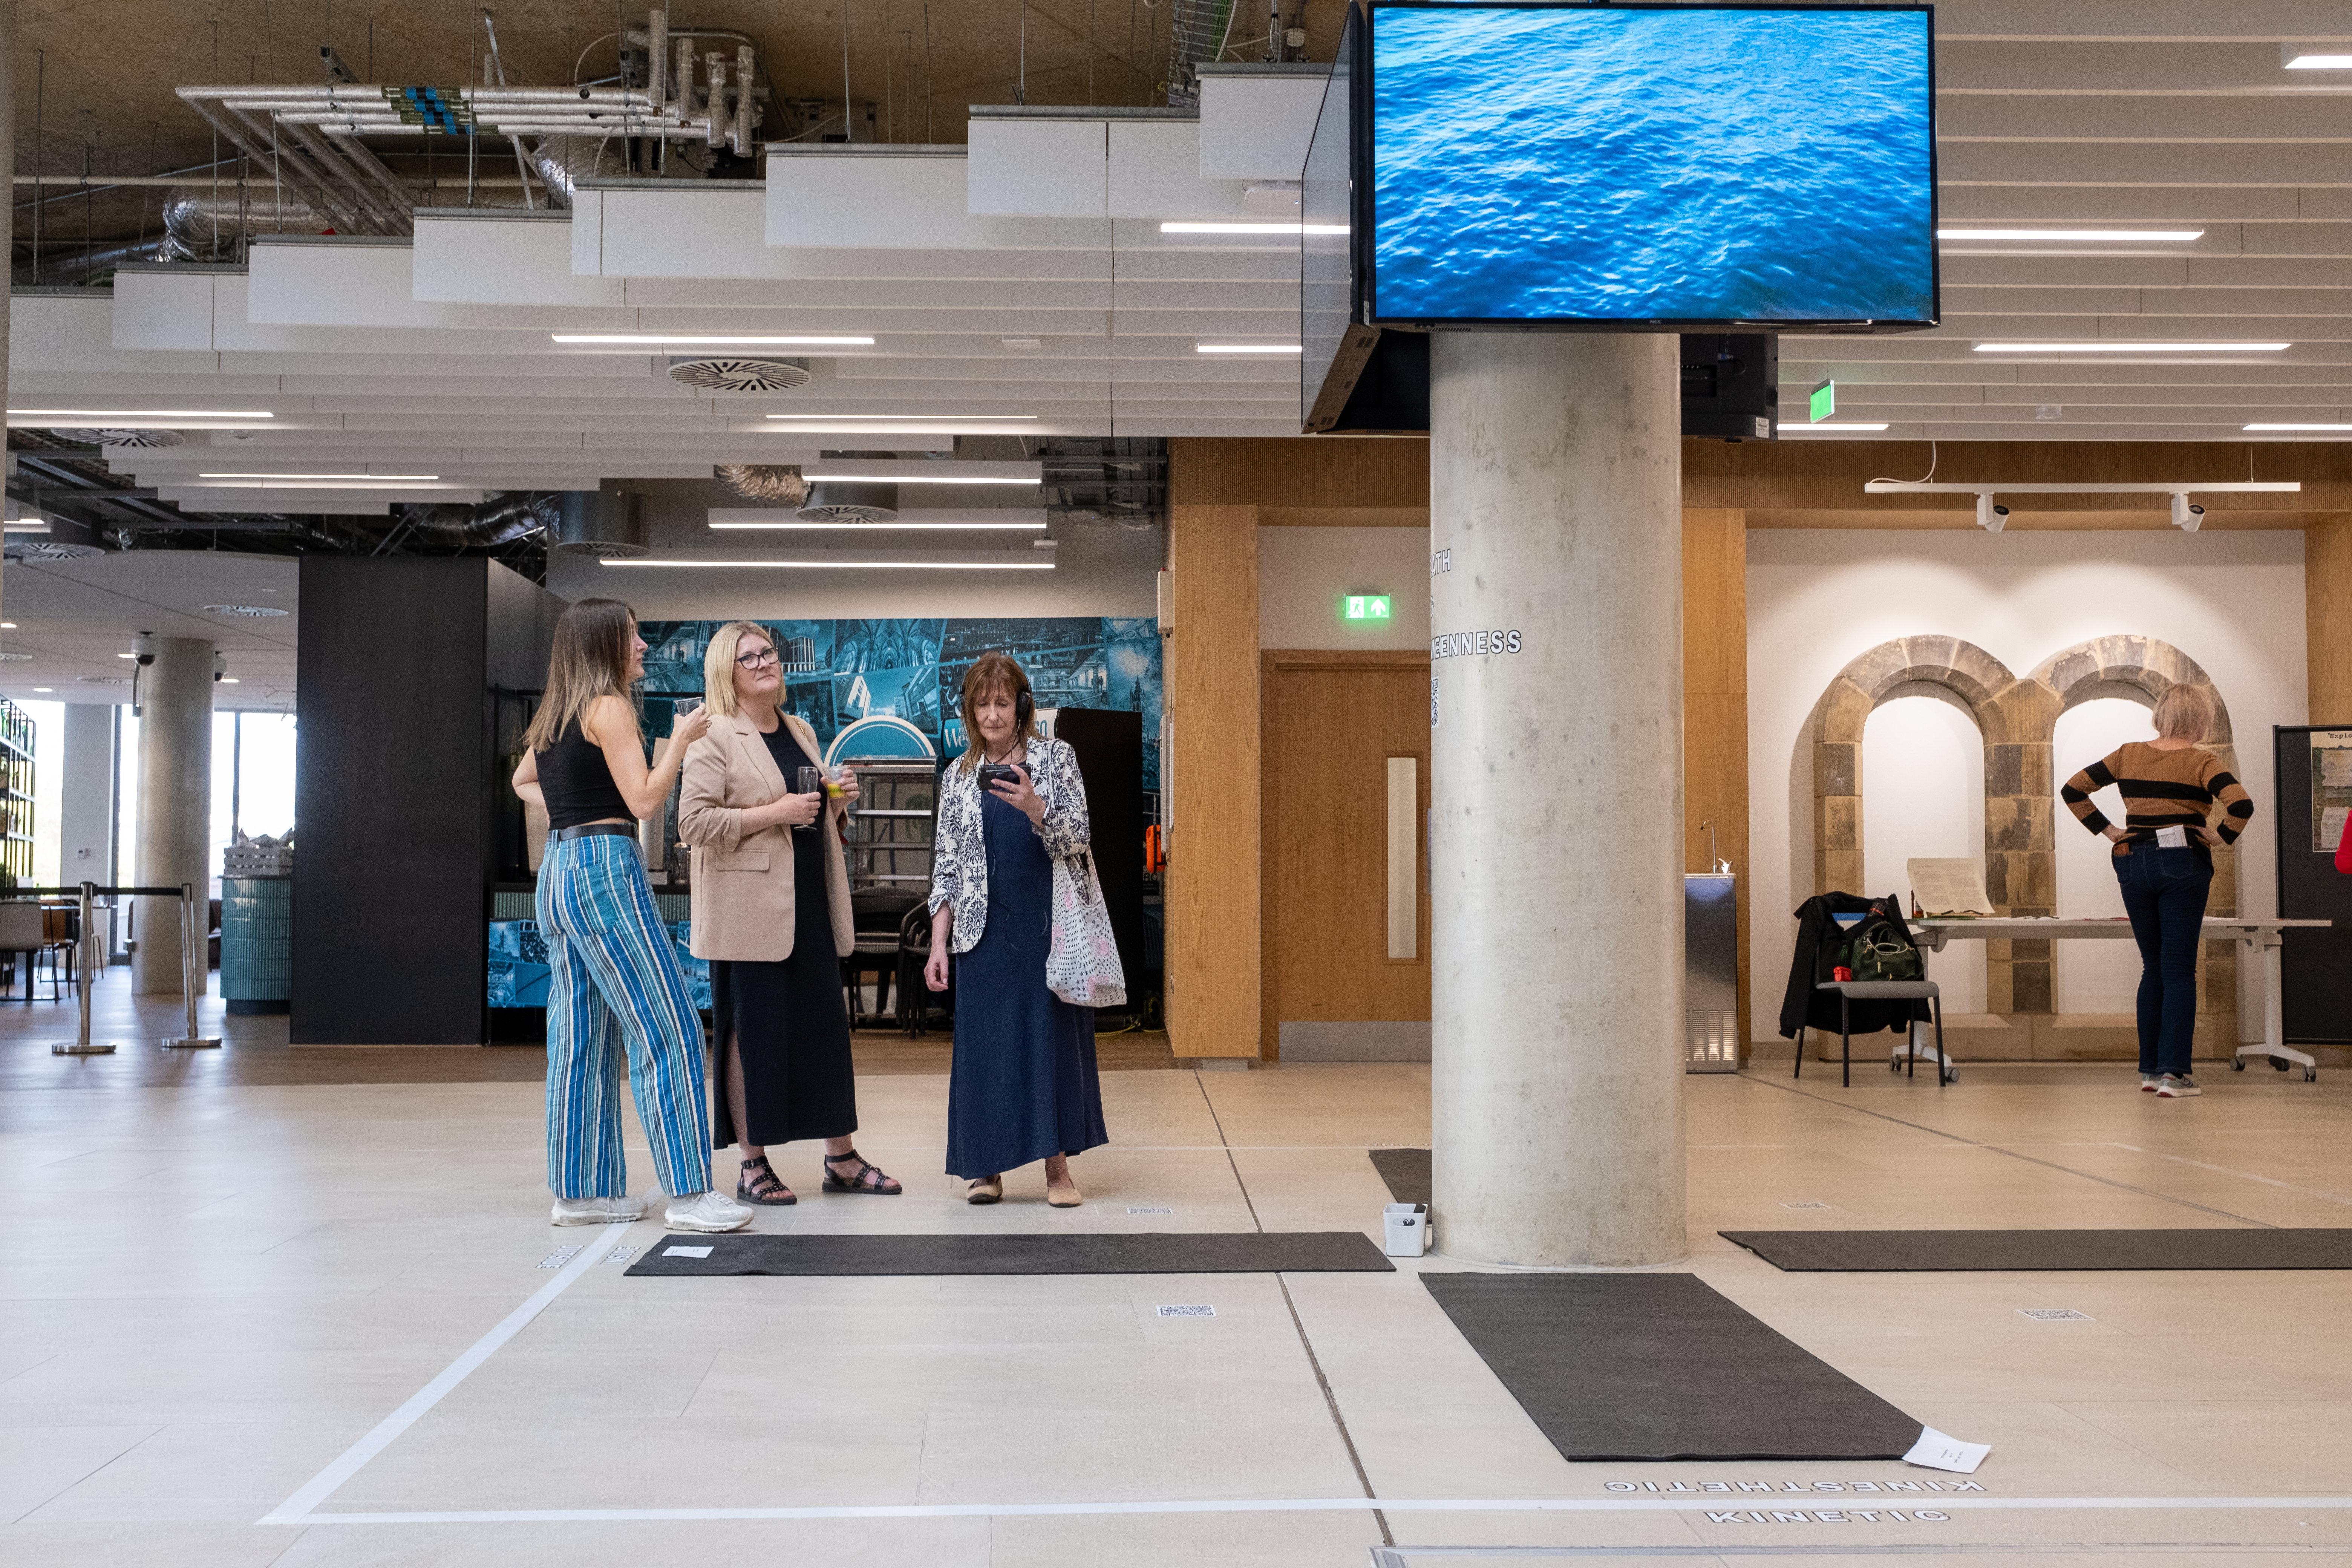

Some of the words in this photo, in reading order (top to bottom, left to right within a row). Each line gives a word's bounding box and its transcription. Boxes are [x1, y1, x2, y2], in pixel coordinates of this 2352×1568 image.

[1430, 548, 1450, 578] ATH
[599, 1246, 641, 1265] INSIDE
[1603, 1481, 1988, 1491] KINESTHETIC
[1703, 1510, 1951, 1523] KINETIC
